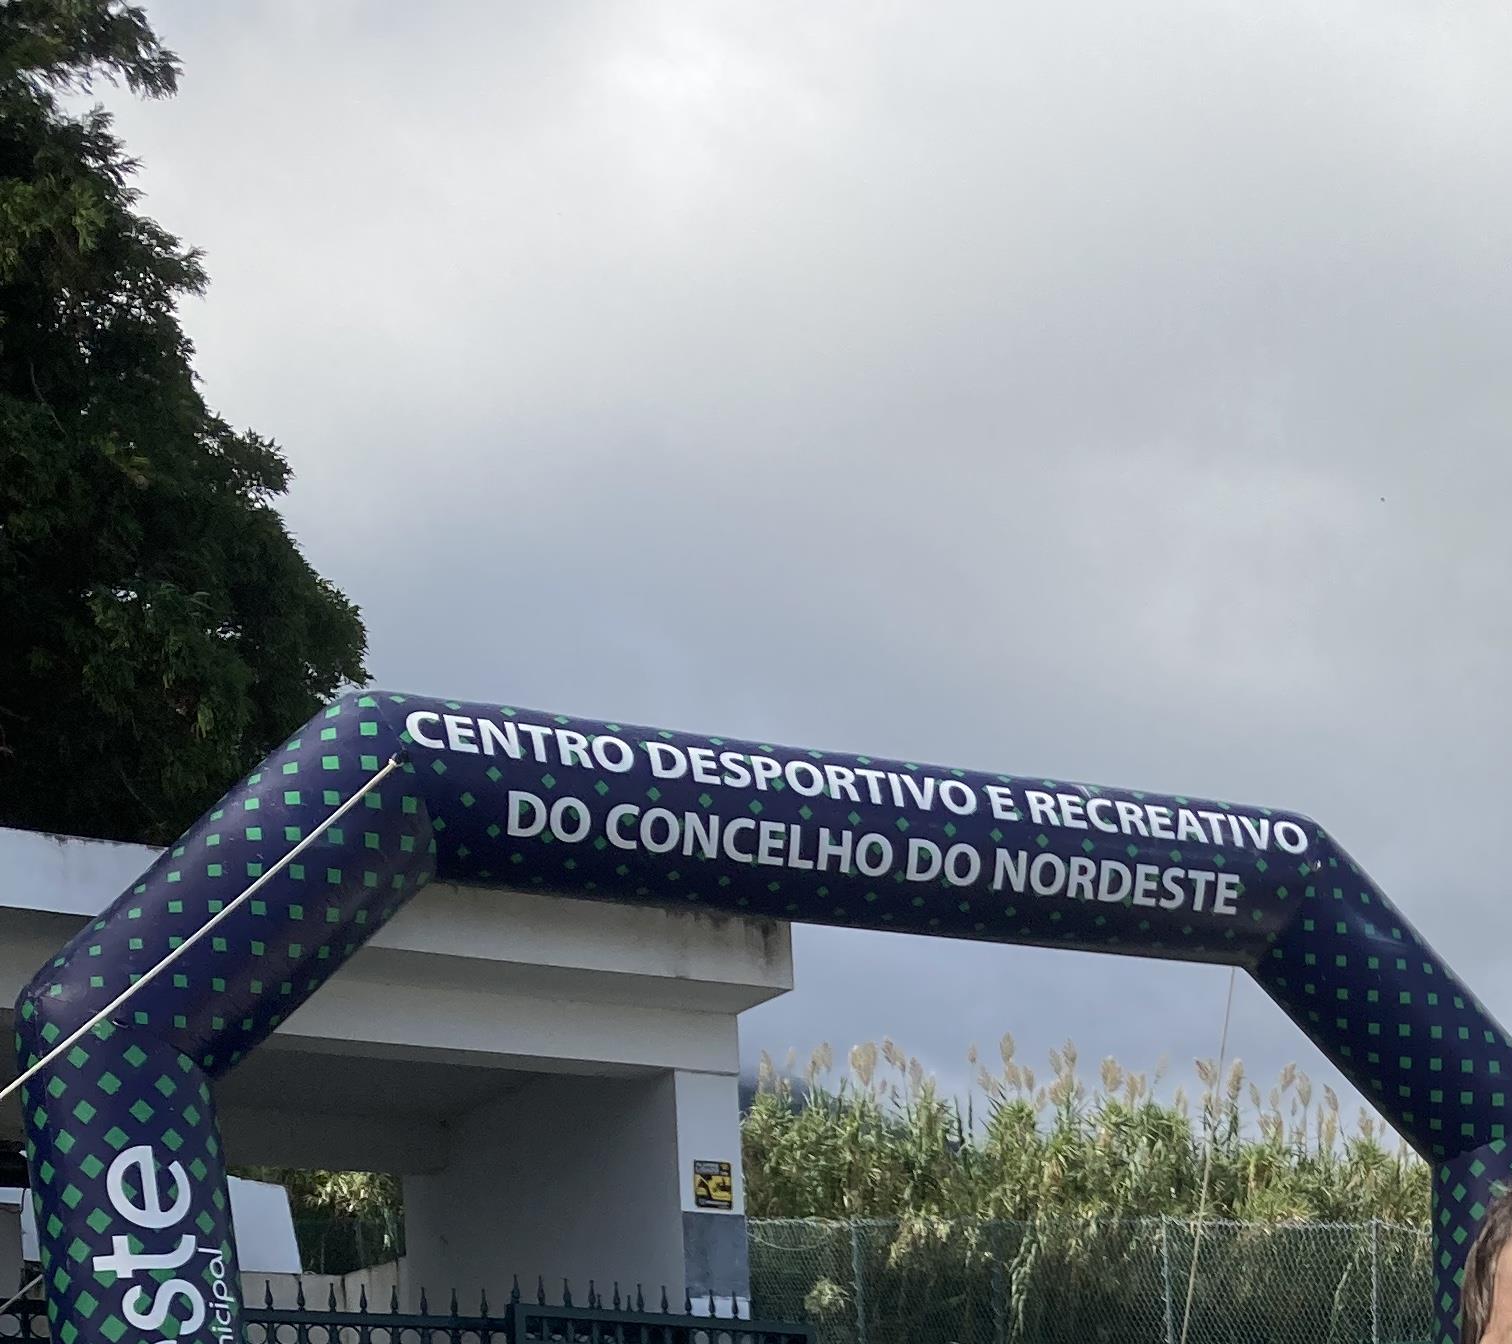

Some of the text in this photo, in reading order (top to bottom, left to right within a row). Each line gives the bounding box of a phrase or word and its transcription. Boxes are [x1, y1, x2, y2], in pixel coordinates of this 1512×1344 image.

[405, 710, 1310, 855] CENTRO DESPORTIVO E RECREATIVO
[506, 791, 1241, 916] DO CONCELHO DO NORDESTE
